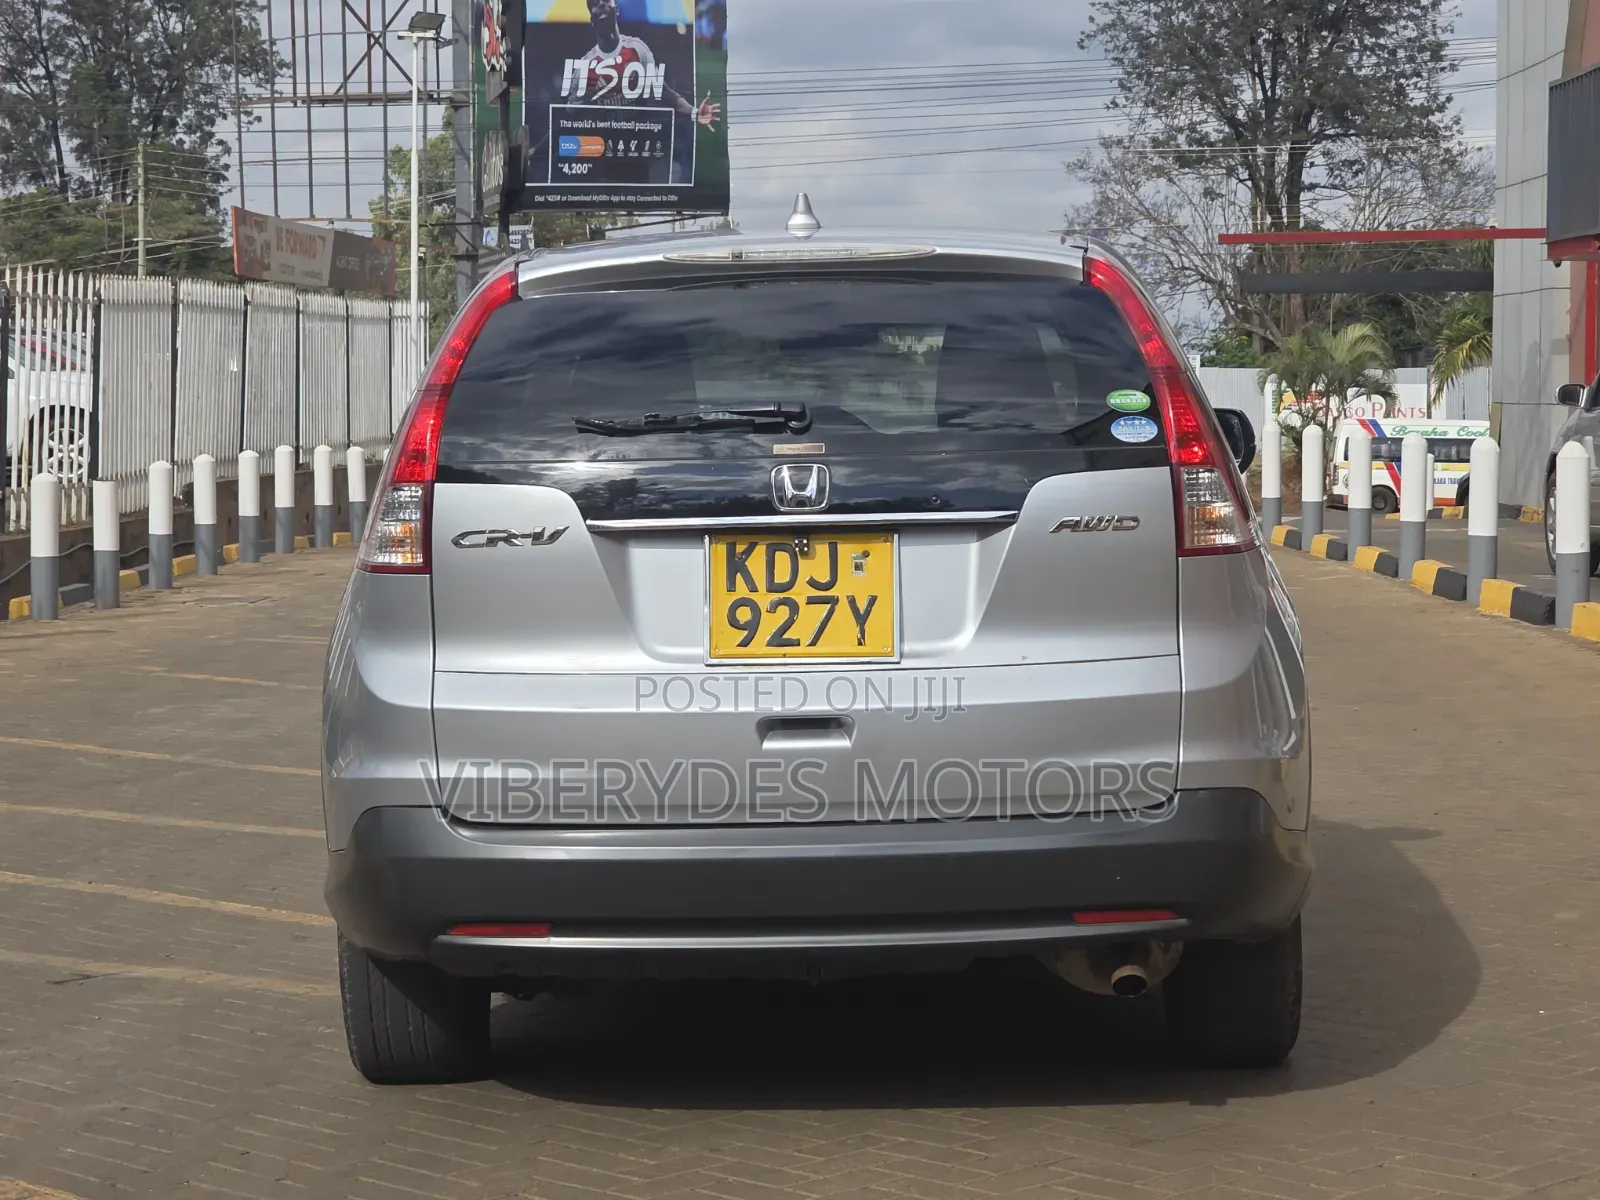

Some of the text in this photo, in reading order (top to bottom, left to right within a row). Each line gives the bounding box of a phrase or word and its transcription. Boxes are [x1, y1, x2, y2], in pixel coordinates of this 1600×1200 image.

[560, 56, 666, 101] IT'S ON
[560, 119, 662, 133] The world's best football package
[562, 163, 588, 175] 4,200
[567, 194, 592, 202] Download
[610, 195, 620, 203] App
[1371, 402, 1426, 418] PINTS
[1456, 425, 1490, 437] Cool
[1049, 514, 1140, 534] AWD
[451, 525, 570, 549] CR-V
[724, 541, 839, 593] KDJ
[726, 594, 878, 647] 927Y
